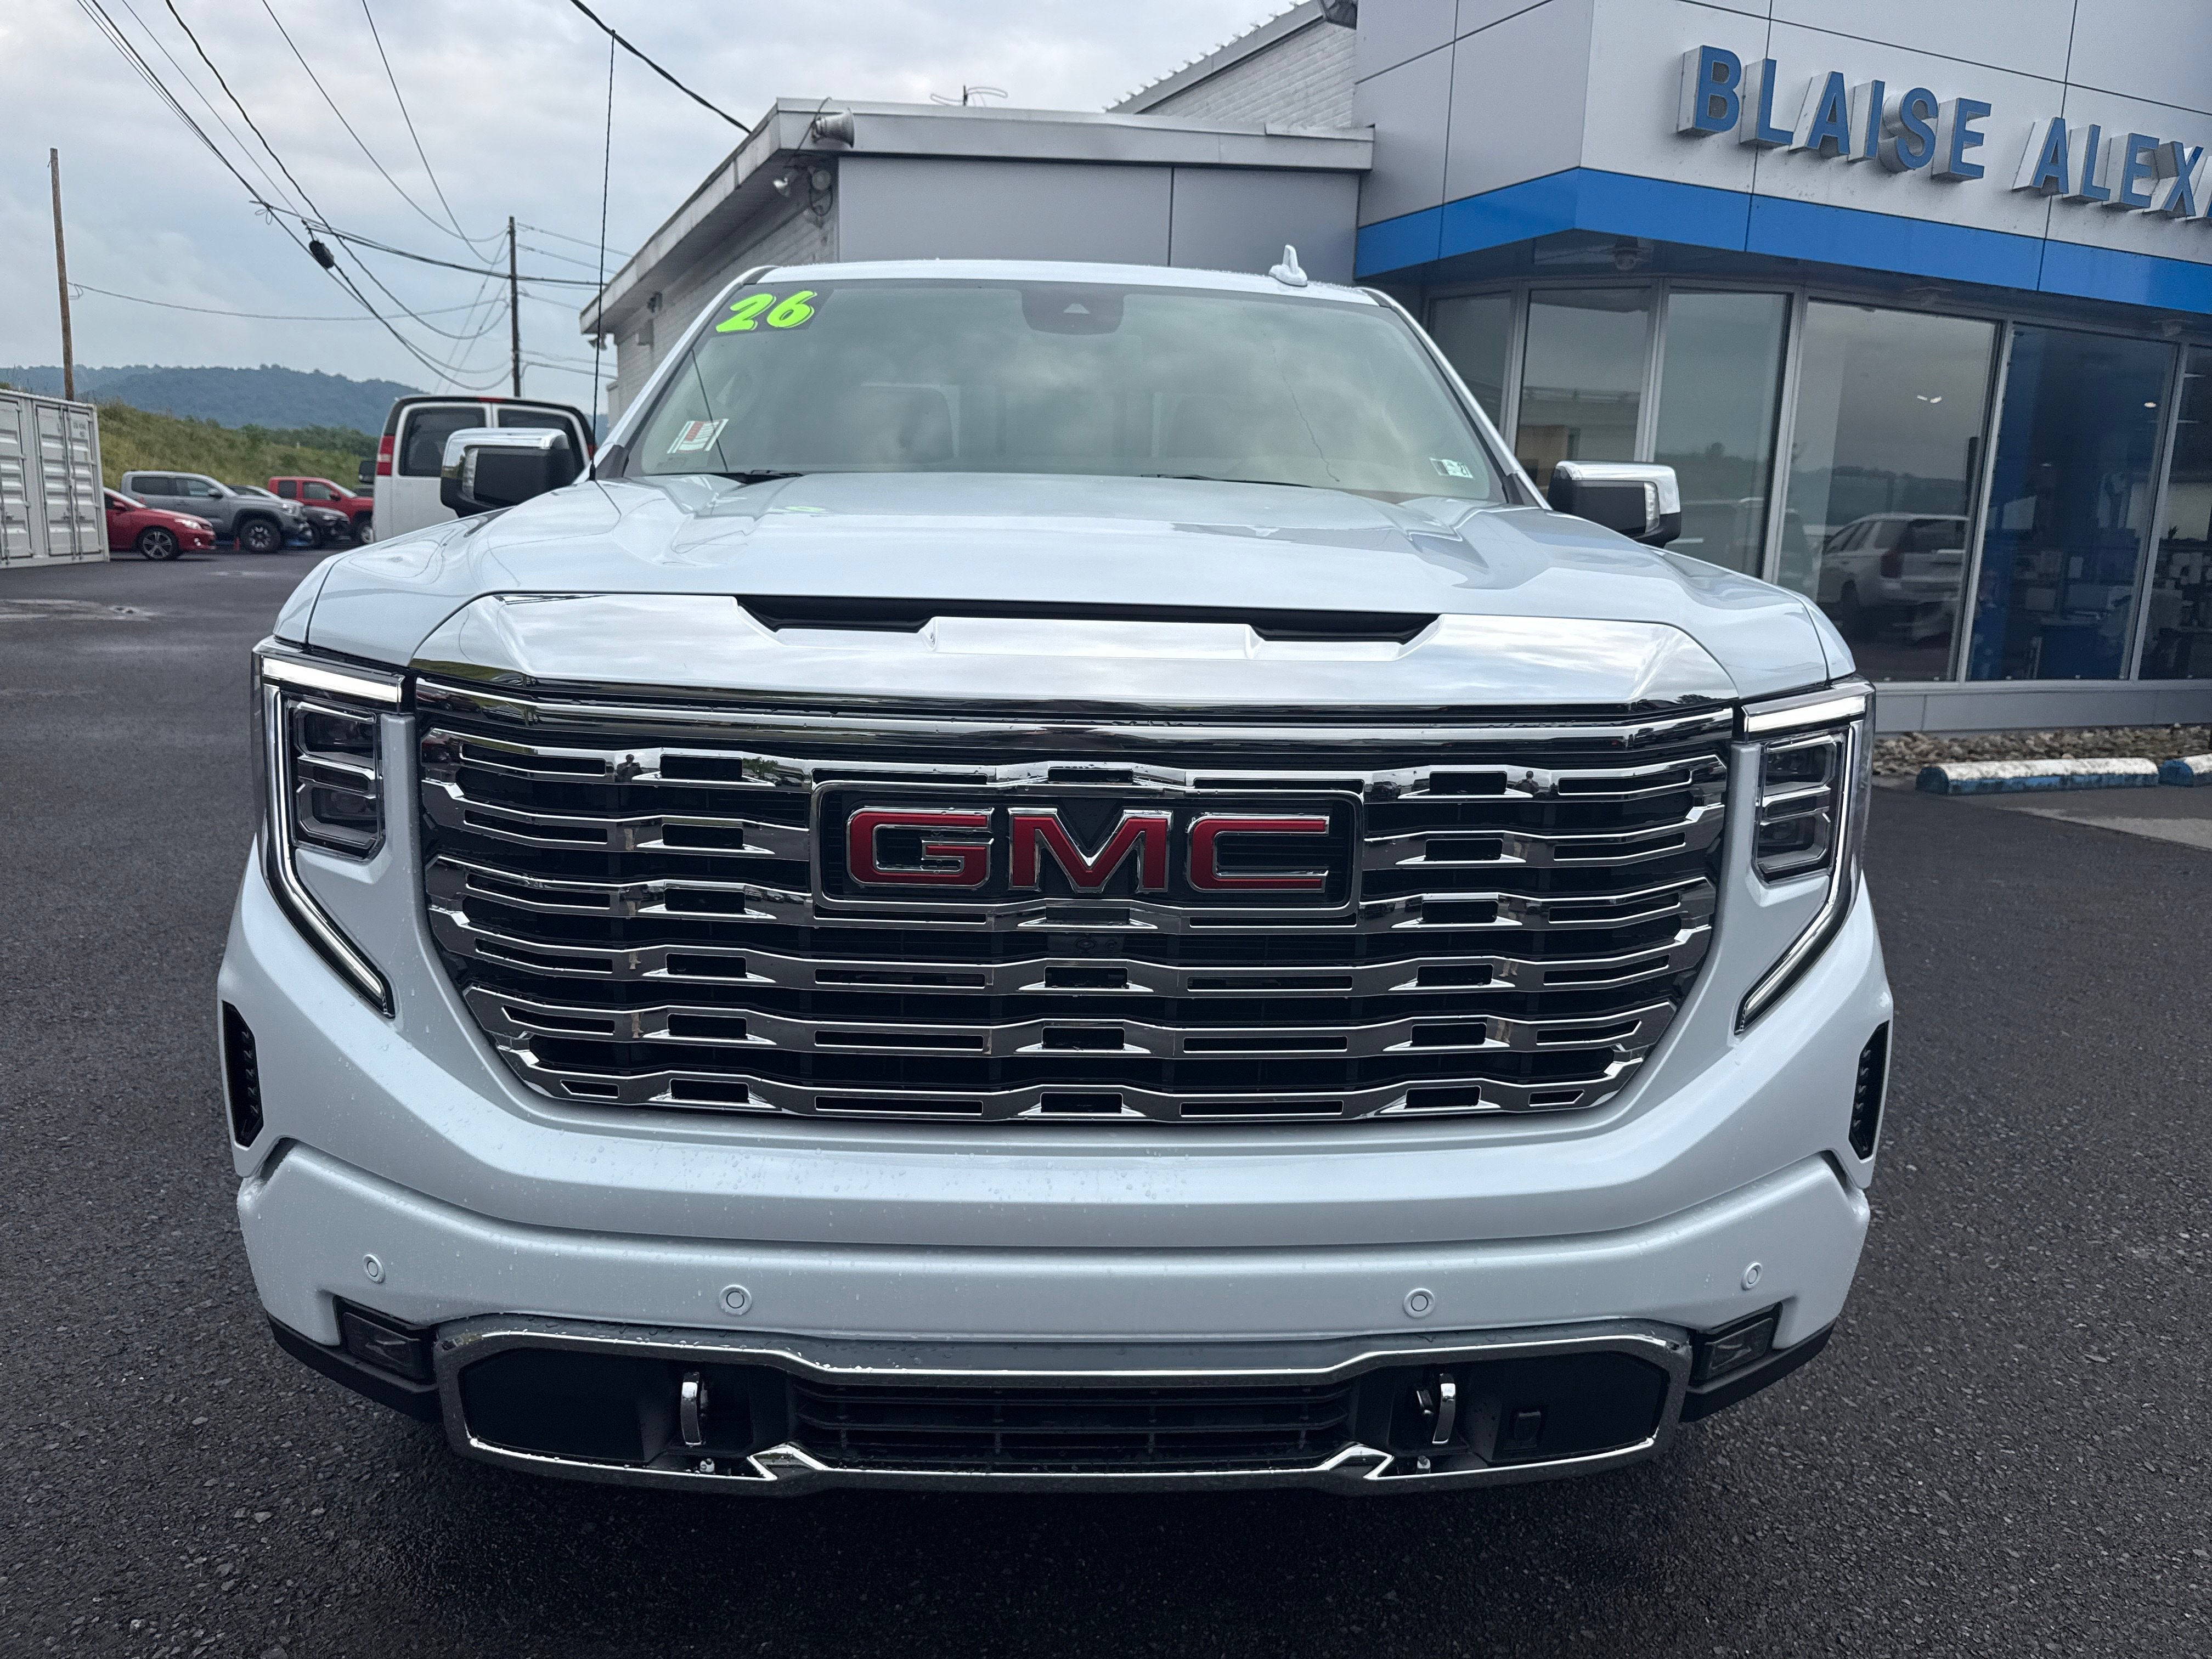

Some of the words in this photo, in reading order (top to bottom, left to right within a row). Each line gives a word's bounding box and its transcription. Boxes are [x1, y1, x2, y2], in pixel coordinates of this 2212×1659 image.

[1690, 46, 1991, 179] BLAISE
[2029, 117, 2212, 219] ALEX
[716, 290, 817, 332] 26
[847, 807, 1329, 894] GMC
